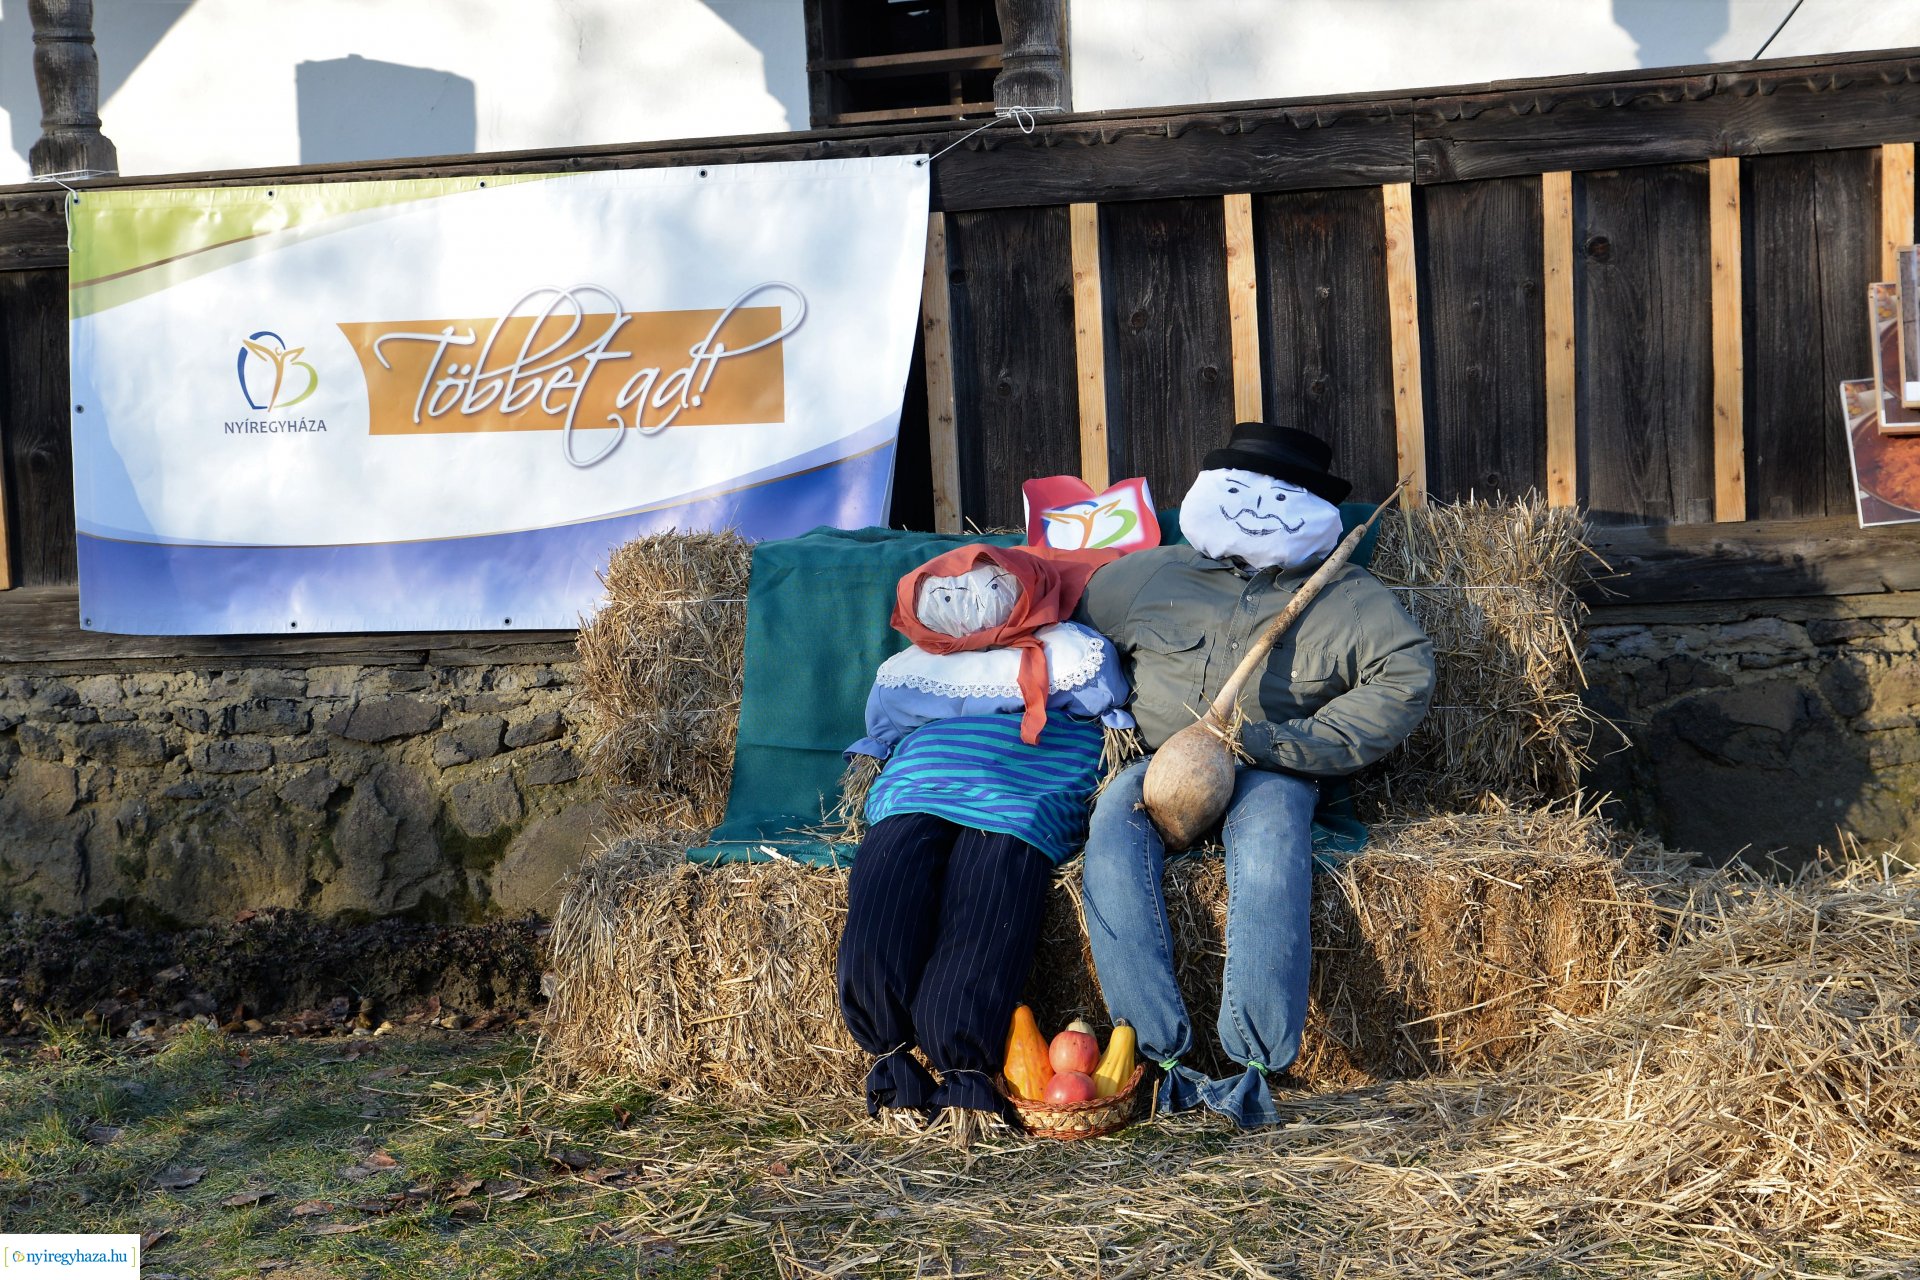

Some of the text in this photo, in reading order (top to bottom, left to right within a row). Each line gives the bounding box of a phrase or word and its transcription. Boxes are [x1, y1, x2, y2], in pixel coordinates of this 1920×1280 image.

[224, 417, 327, 434] NYÍREGYHÁZA
[374, 281, 807, 468] Többet ad!
